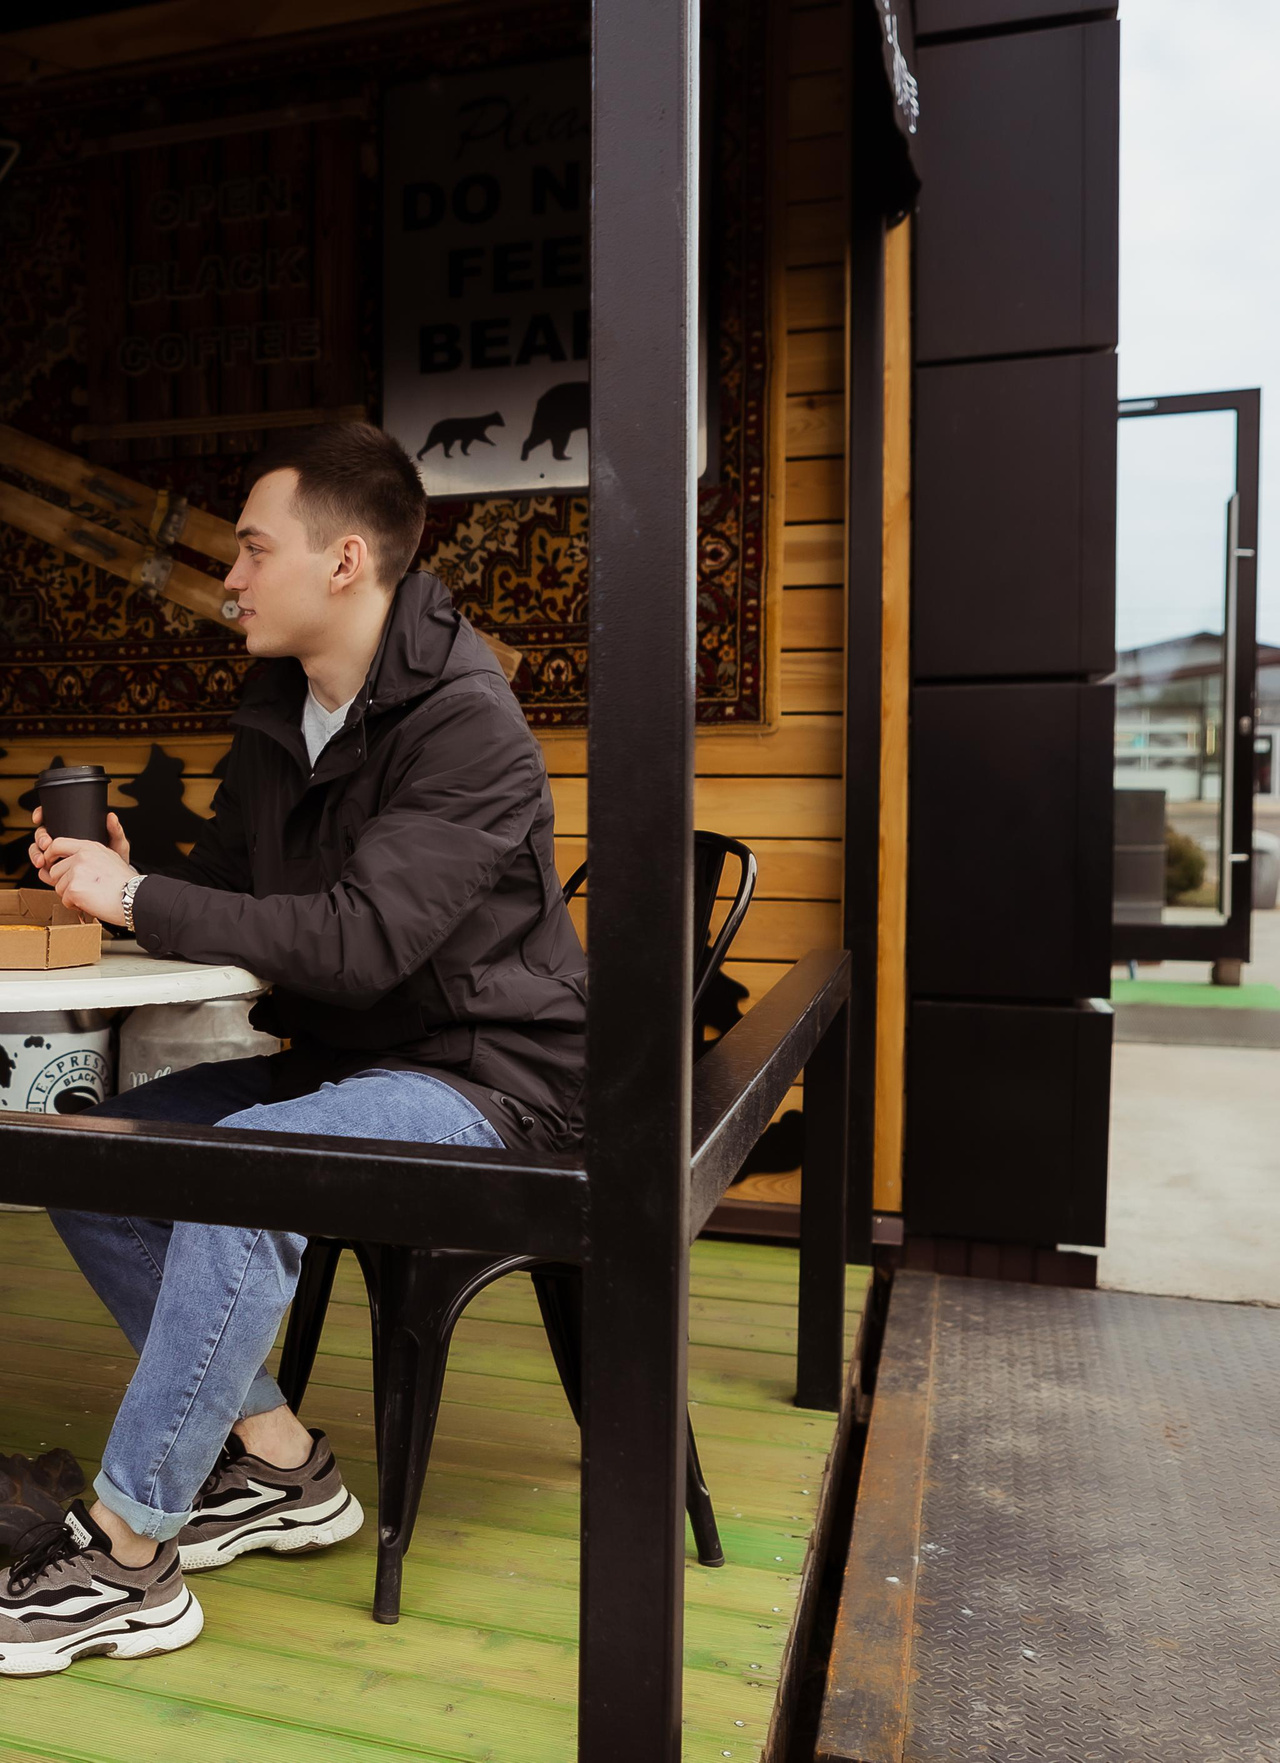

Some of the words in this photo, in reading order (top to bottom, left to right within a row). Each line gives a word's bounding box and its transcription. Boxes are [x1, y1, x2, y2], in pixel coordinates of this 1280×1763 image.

[456, 96, 590, 161] Plea
[150, 174, 292, 230] OPEN
[402, 173, 500, 231] DO
[128, 246, 308, 306] BLACK
[448, 235, 584, 298] FEE
[118, 317, 321, 375] COFFEE
[420, 308, 591, 374] BEA
[63, 1072, 96, 1087] BLACK
[68, 1517, 88, 1541] FASHION
